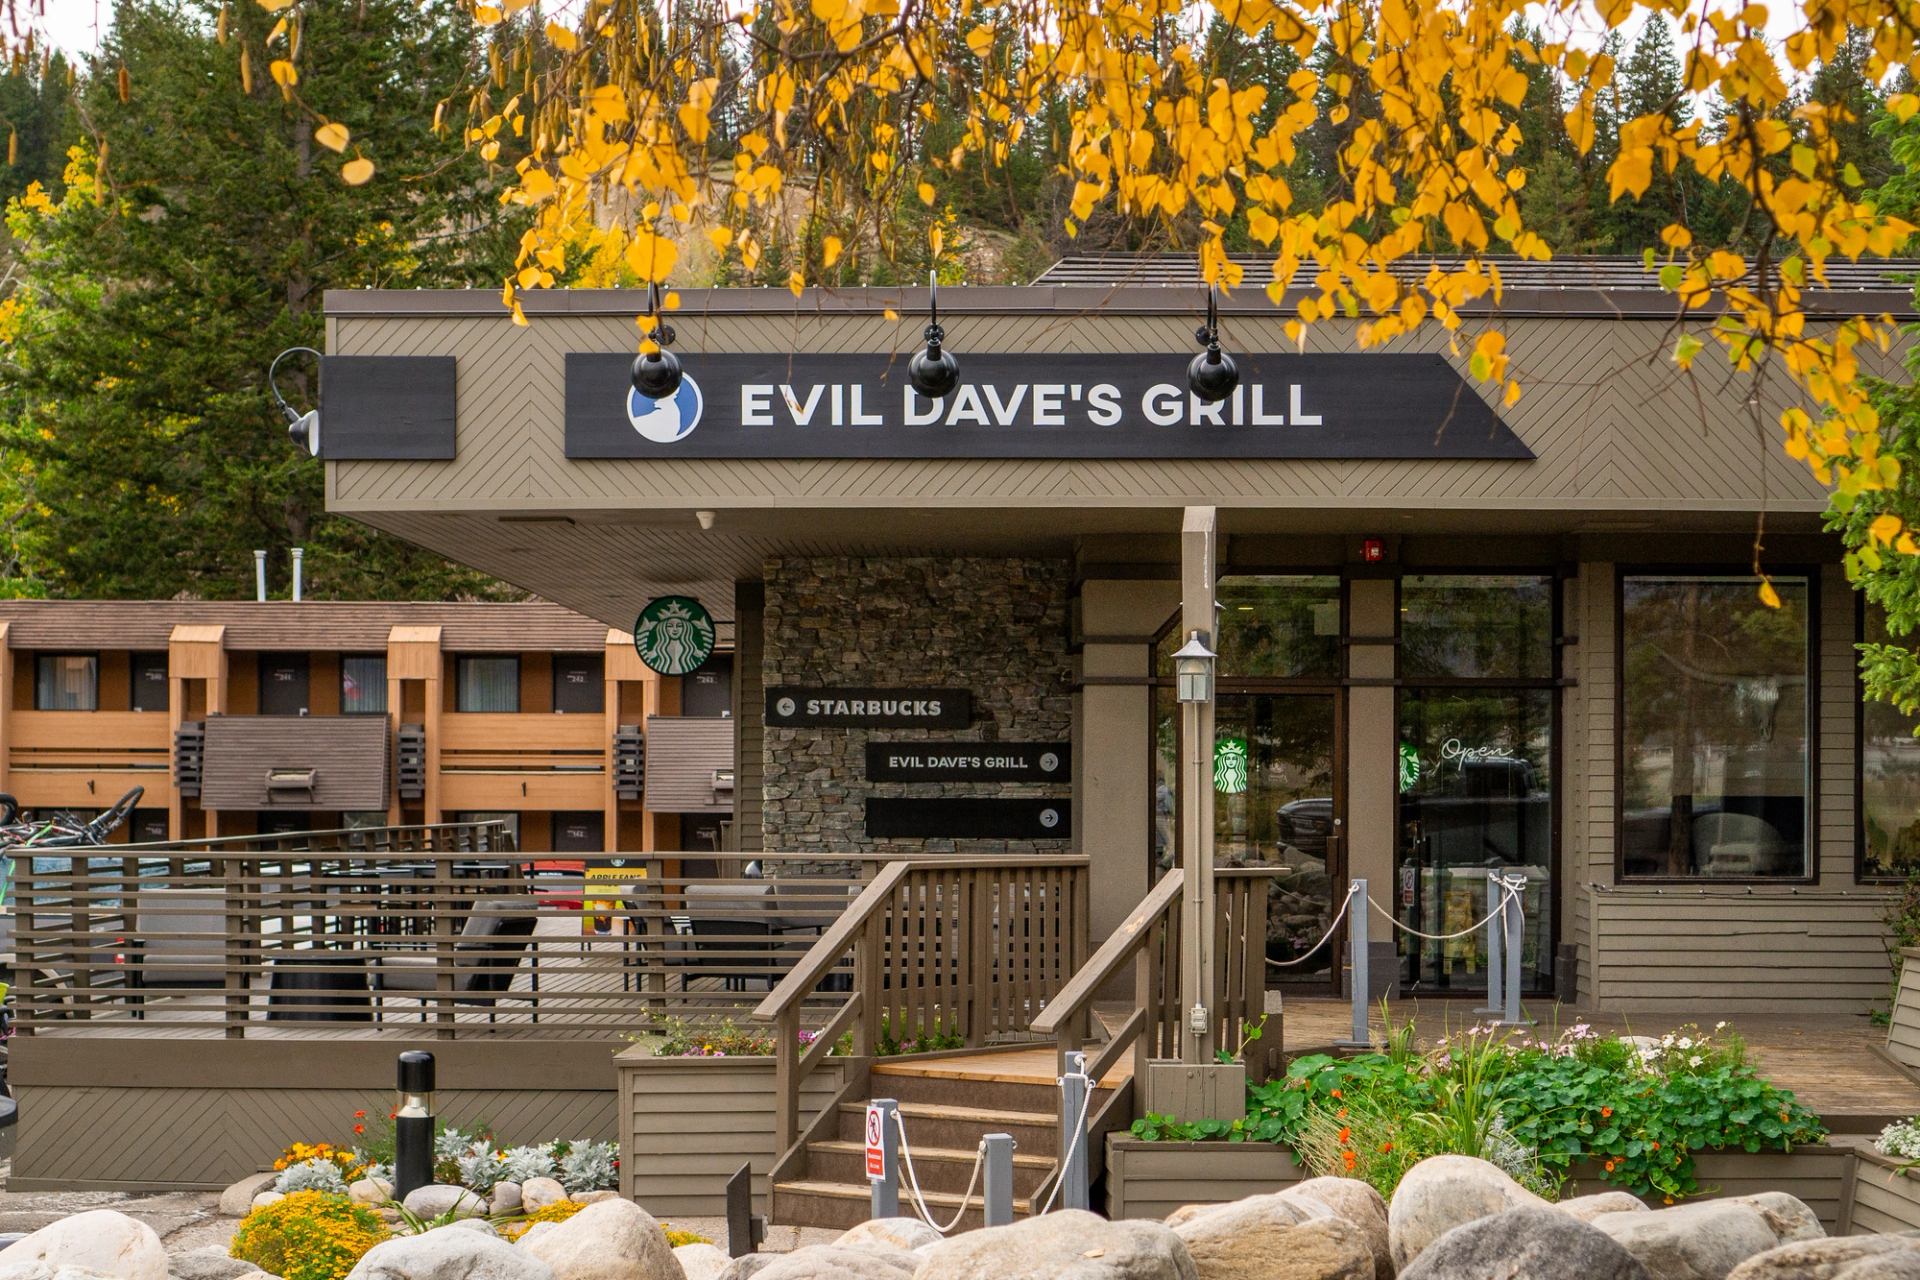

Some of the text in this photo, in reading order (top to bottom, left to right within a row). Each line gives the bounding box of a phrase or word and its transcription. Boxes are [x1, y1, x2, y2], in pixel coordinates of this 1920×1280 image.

[741, 383, 1323, 427] EVIL DAVE'S GRILL
[806, 699, 941, 716] STARBUCKS
[889, 756, 1028, 768] EVIL DAVE'S GRILL
[1441, 738, 1514, 772] Open
